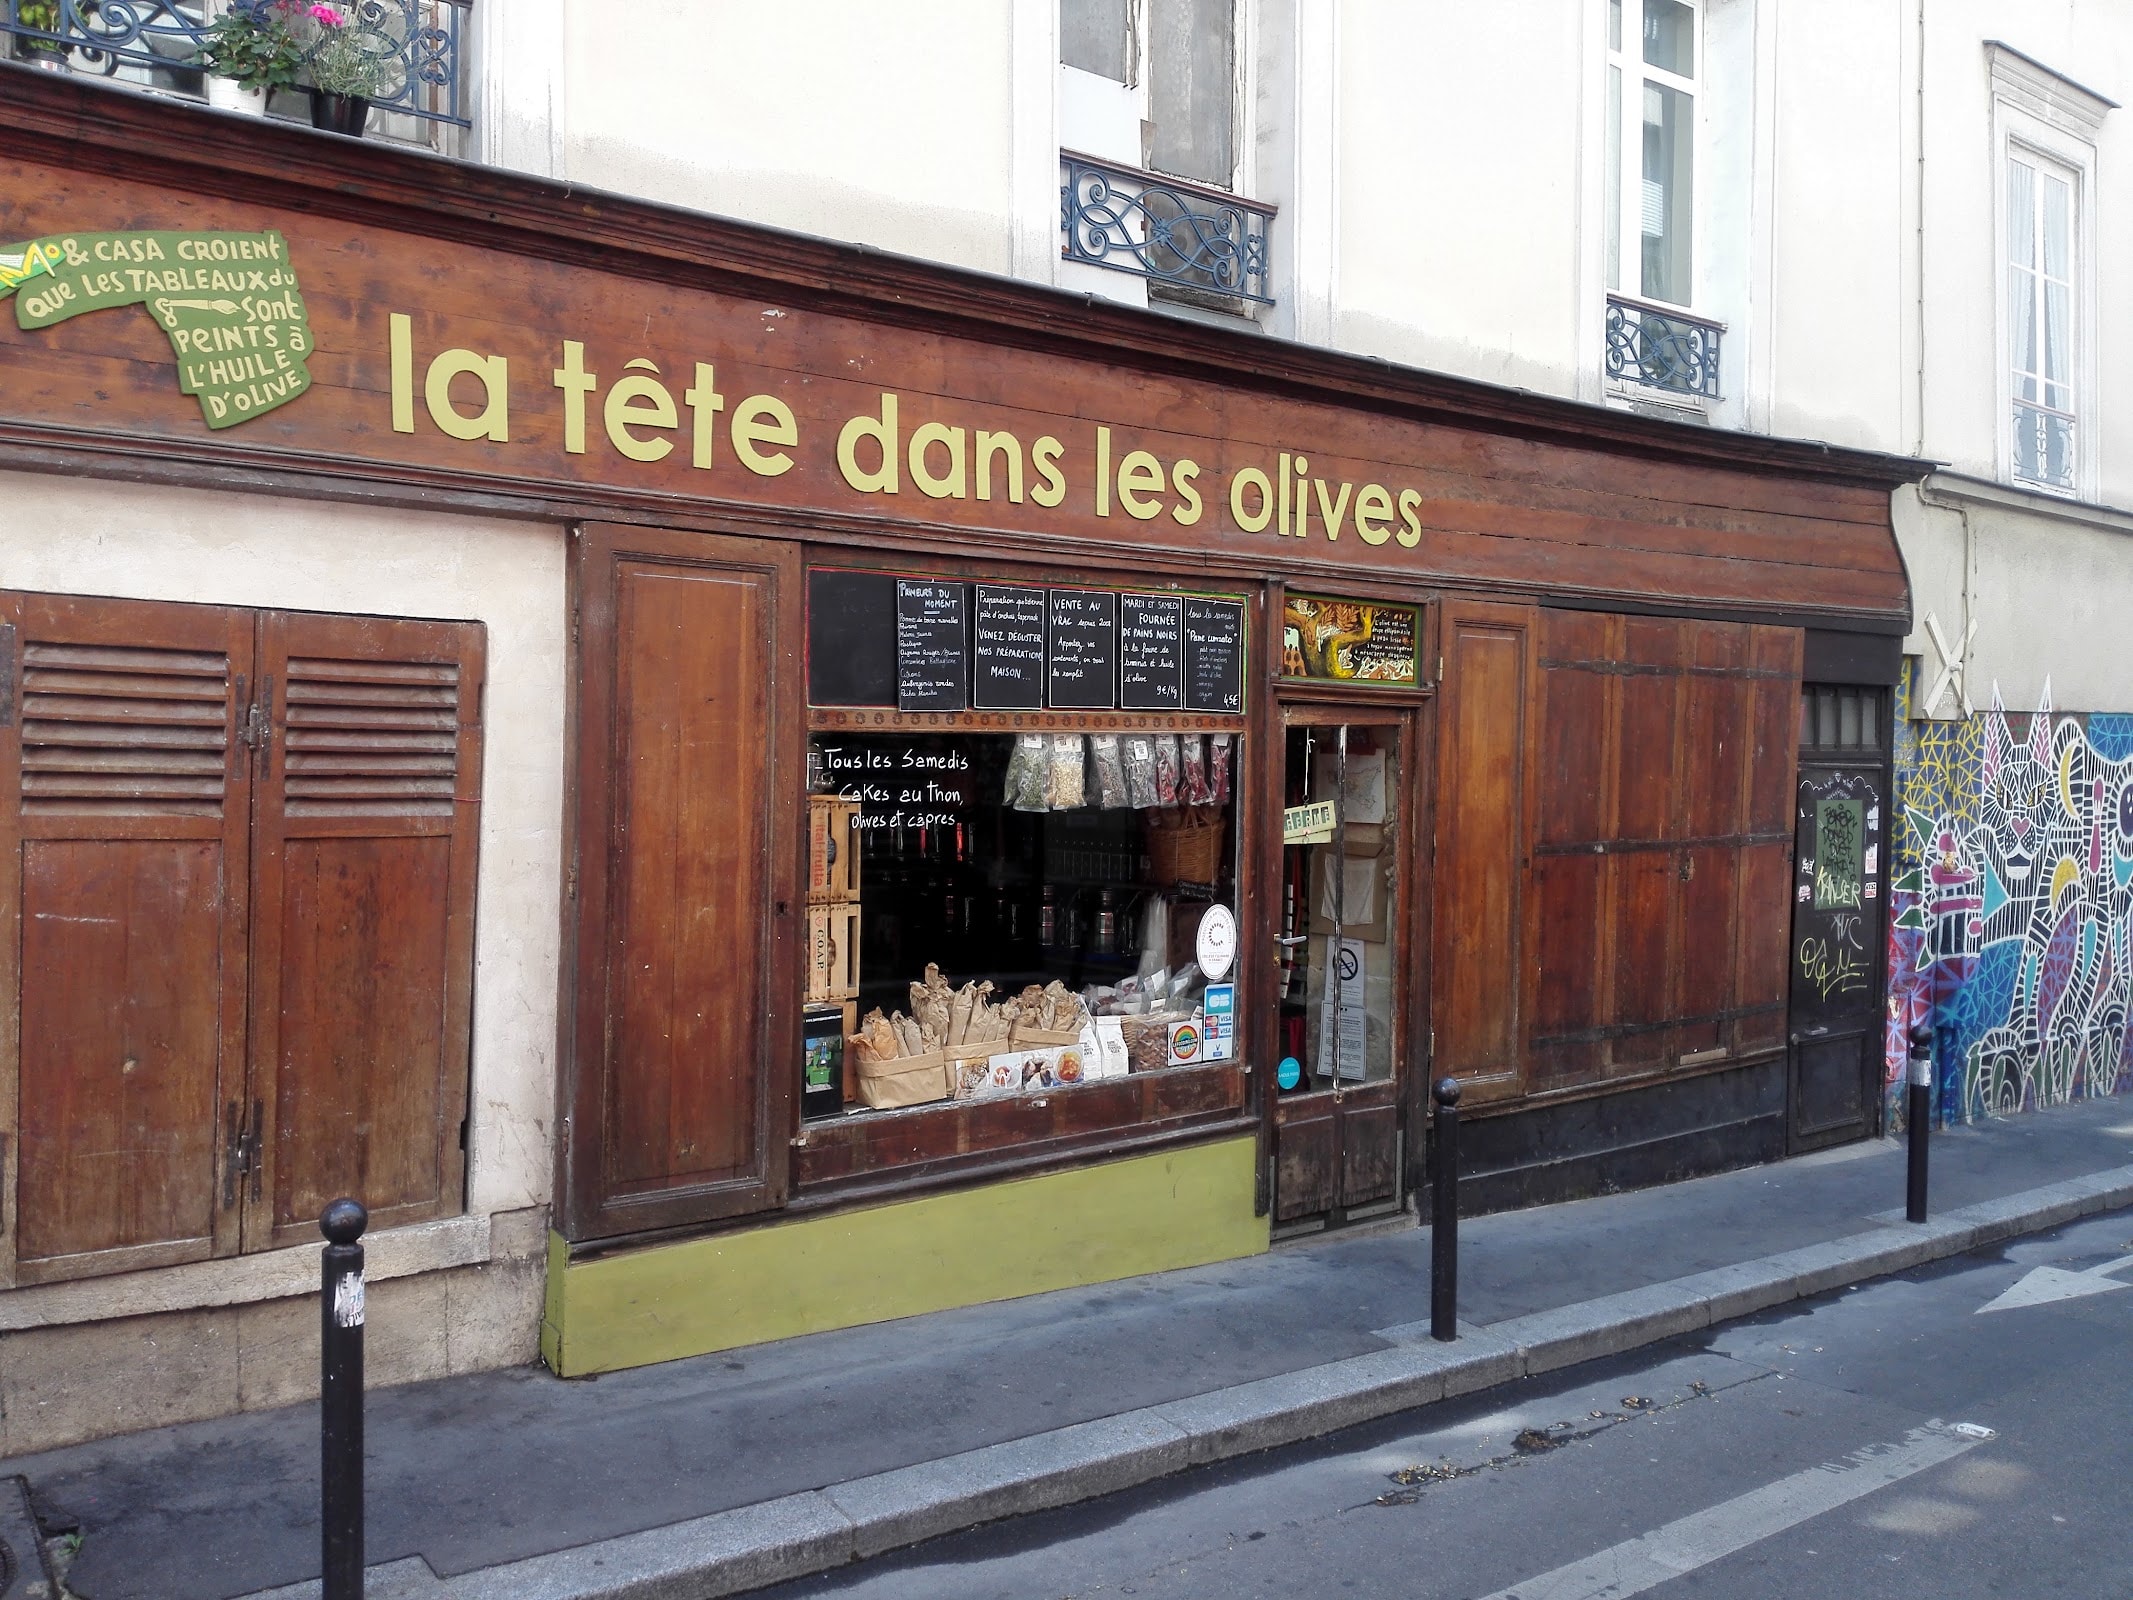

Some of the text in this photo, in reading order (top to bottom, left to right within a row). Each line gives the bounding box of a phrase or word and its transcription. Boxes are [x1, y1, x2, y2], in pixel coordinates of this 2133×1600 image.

[62, 238, 90, 266] &
[94, 239, 165, 263] CASA
[125, 267, 269, 292] TABLEAUX
[269, 268, 295, 287] du
[187, 349, 291, 388] L'HUILE
[390, 313, 1423, 548] la tête dans les olives
[938, 589, 950, 599] DU
[924, 599, 958, 609] MOMENT
[1053, 599, 1101, 611] VENTE AU
[1123, 598, 1145, 608] MARDI
[1157, 600, 1179, 610] SAMEDI
[1051, 614, 1073, 626] VRAC
[1138, 612, 1176, 626] FOURNÉE
[978, 628, 1005, 640] VENEZ
[1122, 627, 1131, 638] DE
[978, 646, 992, 656] NOS
[824, 748, 969, 770] Tous les Samedis
[899, 788, 922, 803] au
[851, 810, 887, 829] olives
[889, 809, 905, 829] et
[1219, 1015, 1232, 1023] VISA
[1219, 1027, 1232, 1036] VISA
